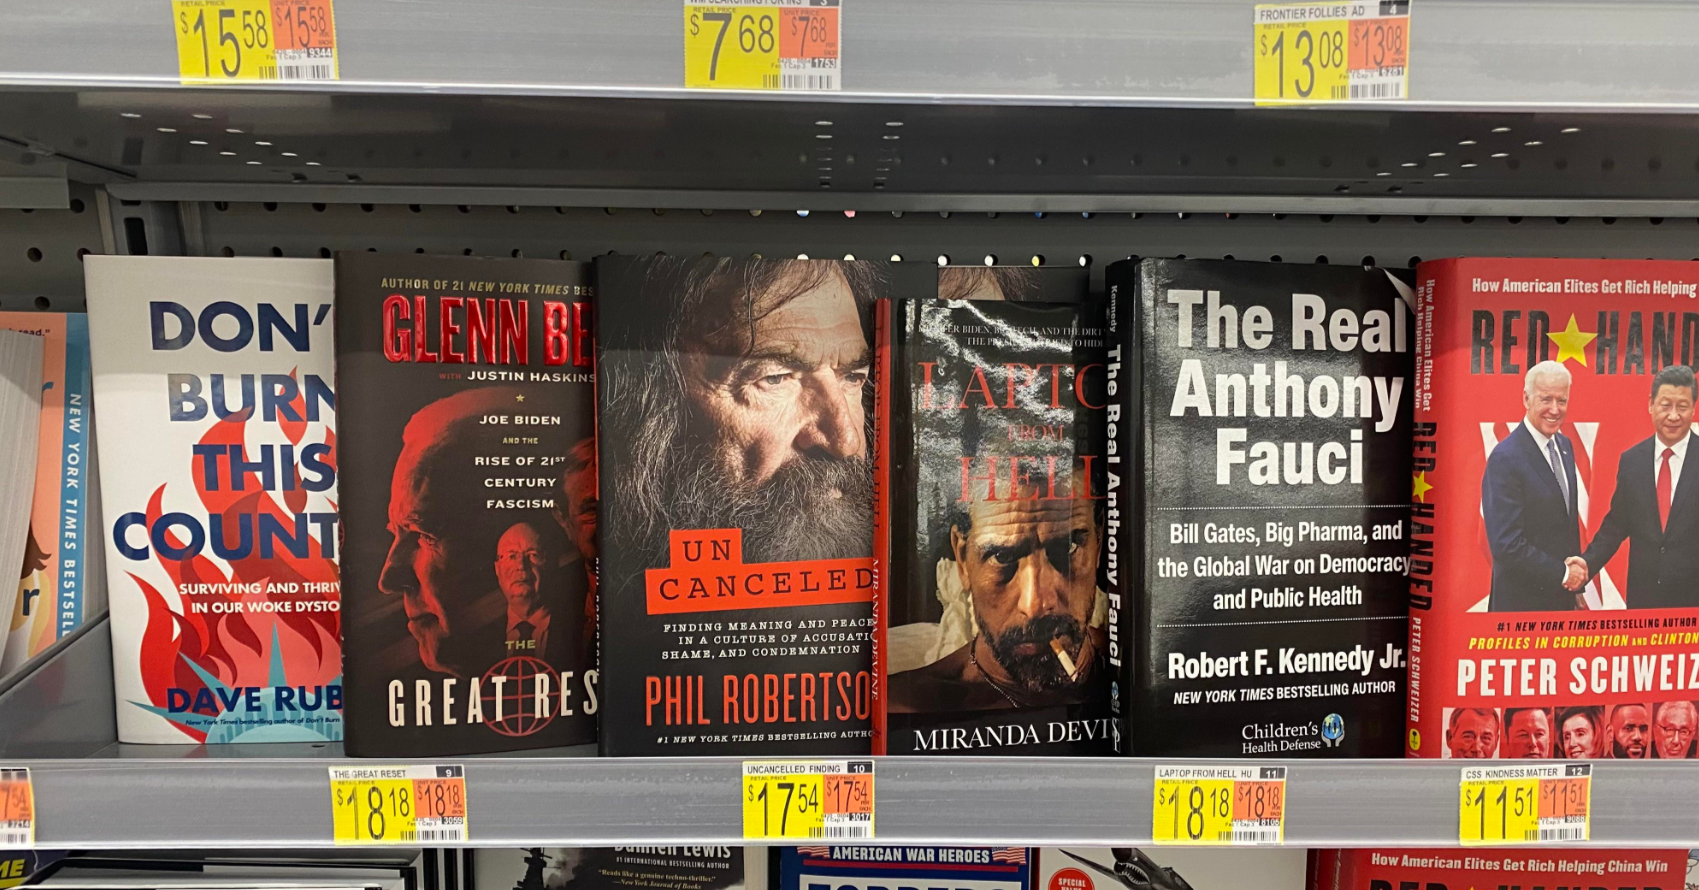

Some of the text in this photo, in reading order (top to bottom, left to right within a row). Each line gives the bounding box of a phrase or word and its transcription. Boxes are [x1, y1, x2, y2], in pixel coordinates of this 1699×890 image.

[1260, 6, 1365, 20] FRONTIER FOLLIES AD
[309, 48, 332, 58] 9344
[814, 58, 836, 68] 1753
[381, 278, 569, 295] AUTHOR OF 21 NEW YORK TIMES
[1472, 278, 1697, 298] How American Elites Get Rich Helping
[1167, 289, 1406, 352] The Real
[382, 293, 528, 365] GLENN
[467, 370, 524, 382] JUSTIN
[530, 372, 596, 383] HASKINS
[168, 373, 335, 423] BURN
[1170, 359, 1404, 433] Anthony
[479, 415, 561, 425] JOE BIDEN
[1007, 424, 1064, 442] FROM
[474, 456, 510, 466] RISE
[515, 456, 536, 466] OF
[1216, 428, 1363, 485] Fauci
[64, 394, 82, 550] NEW YORK TIMES
[192, 443, 336, 492] THIS
[484, 478, 557, 488] CENTURY
[956, 455, 1106, 502] HELL
[486, 499, 554, 509] FASCISM
[1106, 344, 1122, 667] The Real Anthony Fauci
[1170, 520, 1403, 547] Bill Gates, Big Pharma, and
[682, 539, 731, 562] UN
[1158, 553, 1411, 578] the Global War on Democracy
[179, 582, 299, 595] SURVIVING AND
[659, 568, 874, 601] CANCELED
[1213, 585, 1362, 610] and Public Health
[191, 601, 292, 614] IN OUR WOKE
[663, 618, 874, 633] FINDING MEANING AND PEACE
[1497, 617, 1697, 632] #1 NEW YORK TIMES BESTSELLING AUTHOR
[505, 640, 536, 650] THE
[678, 633, 798, 645] IN A CULTURE OF
[1468, 635, 1647, 650] PROFILES IN CORRUPTION AND
[661, 645, 861, 660] SHAME, AND CONDEMNATION
[1169, 643, 1405, 679] Robert F. Kennedy Jr.
[1410, 616, 1422, 723] PETER SCHWEIZER
[1457, 658, 1557, 696] PETER
[167, 686, 262, 714] DAVE
[645, 675, 711, 726] PHIL
[1174, 680, 1396, 705] NEW YORK TIMES BESTSELLING AUTHOR
[388, 675, 507, 727] GREAT
[239, 718, 272, 726] bestselling
[656, 731, 837, 744] #1 NEW YORK TIMES BESTSELLING
[913, 724, 1041, 751] MIRANDA
[1242, 722, 1318, 740] Children's
[1242, 739, 1321, 754] Health Defense
[334, 770, 351, 778] THE
[352, 770, 378, 778] GREAT
[747, 765, 841, 774] UNCANCELLED FINDING
[1160, 769, 1252, 778] LAPTOP FROM HELL HU
[1266, 770, 1277, 778] 11
[1466, 768, 1558, 779] CSS KINDNESS MATTER
[624, 857, 667, 866] INTERNATIONAL
[669, 860, 705, 868] BESTSELLING
[833, 847, 990, 863] AMERICAN WAR HEROES
[1371, 853, 1668, 875] How American Elites Get Rich Helping China Win
[1058, 878, 1086, 887] SPECIAL
